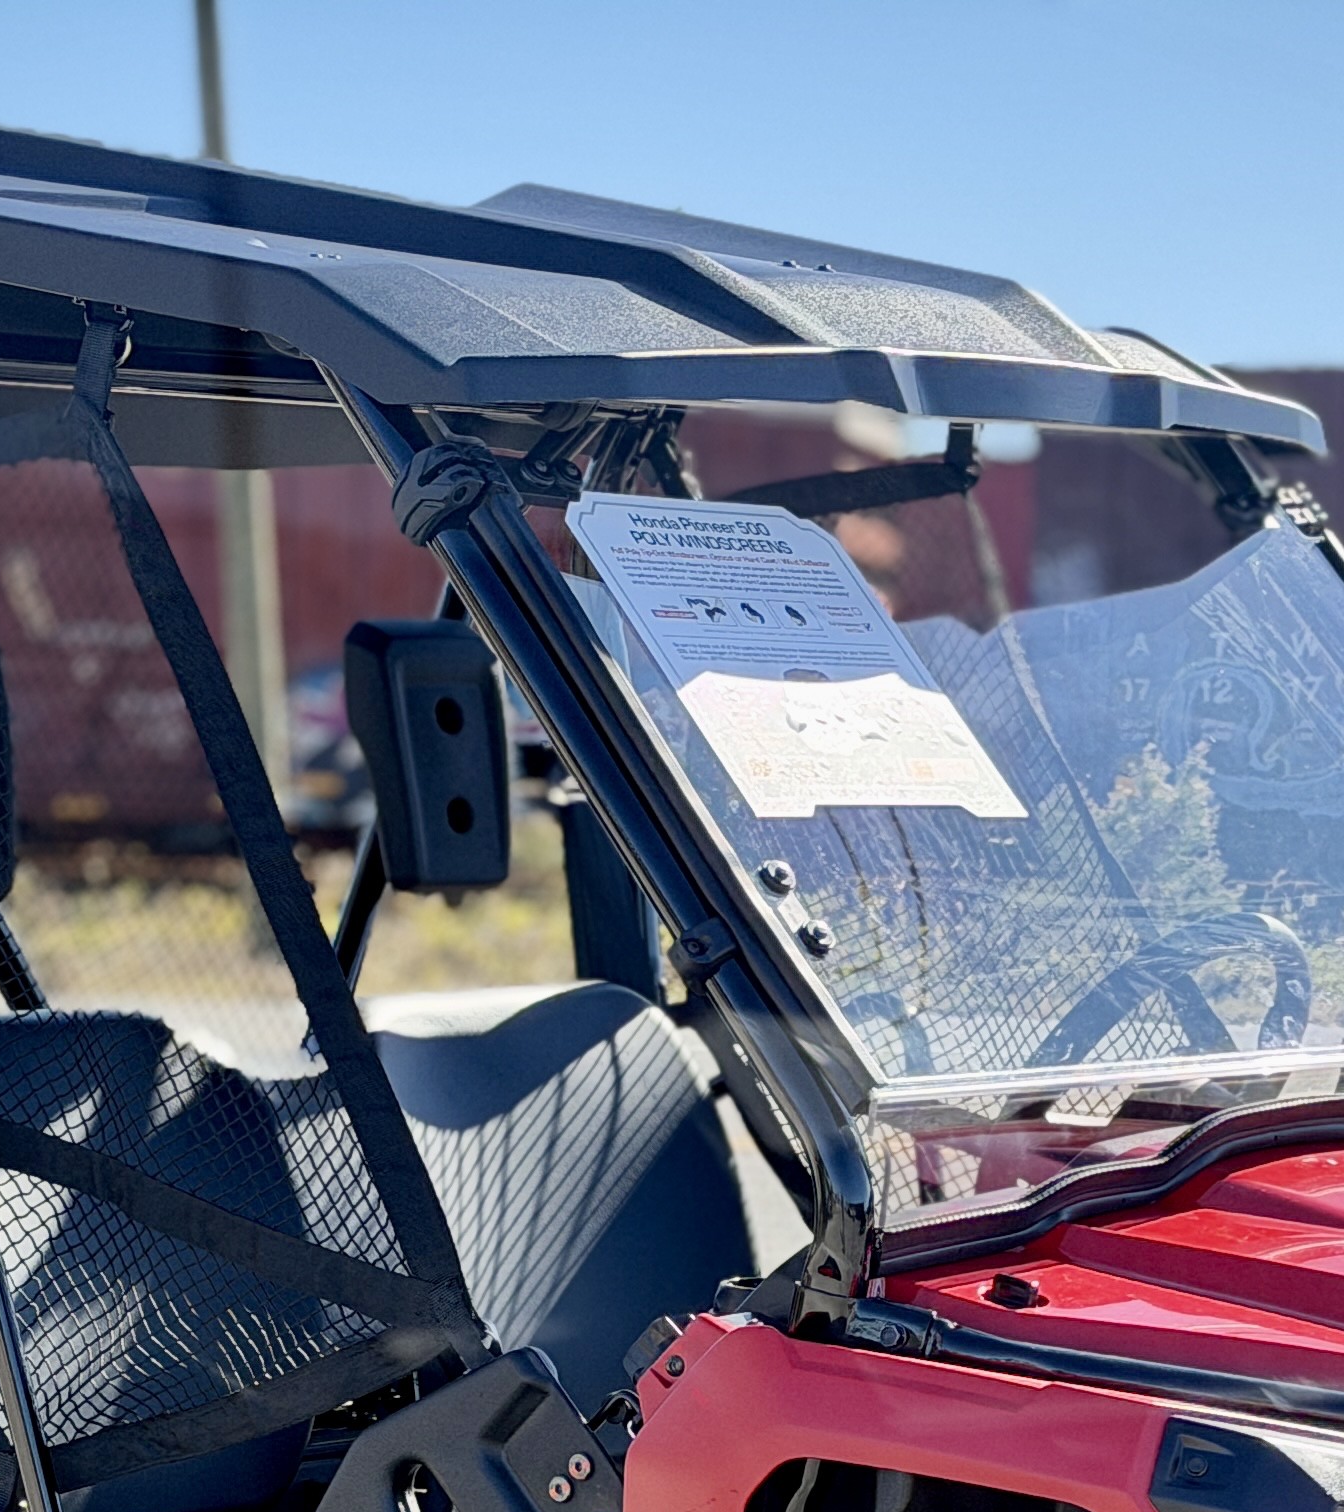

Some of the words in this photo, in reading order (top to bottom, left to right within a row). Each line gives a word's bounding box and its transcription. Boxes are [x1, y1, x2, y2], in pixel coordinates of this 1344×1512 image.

[627, 512, 680, 531] Honda
[677, 516, 736, 535] Pioneer
[734, 521, 772, 537] 500
[629, 530, 674, 548] POLY
[671, 534, 794, 555] WINDSCREENS
